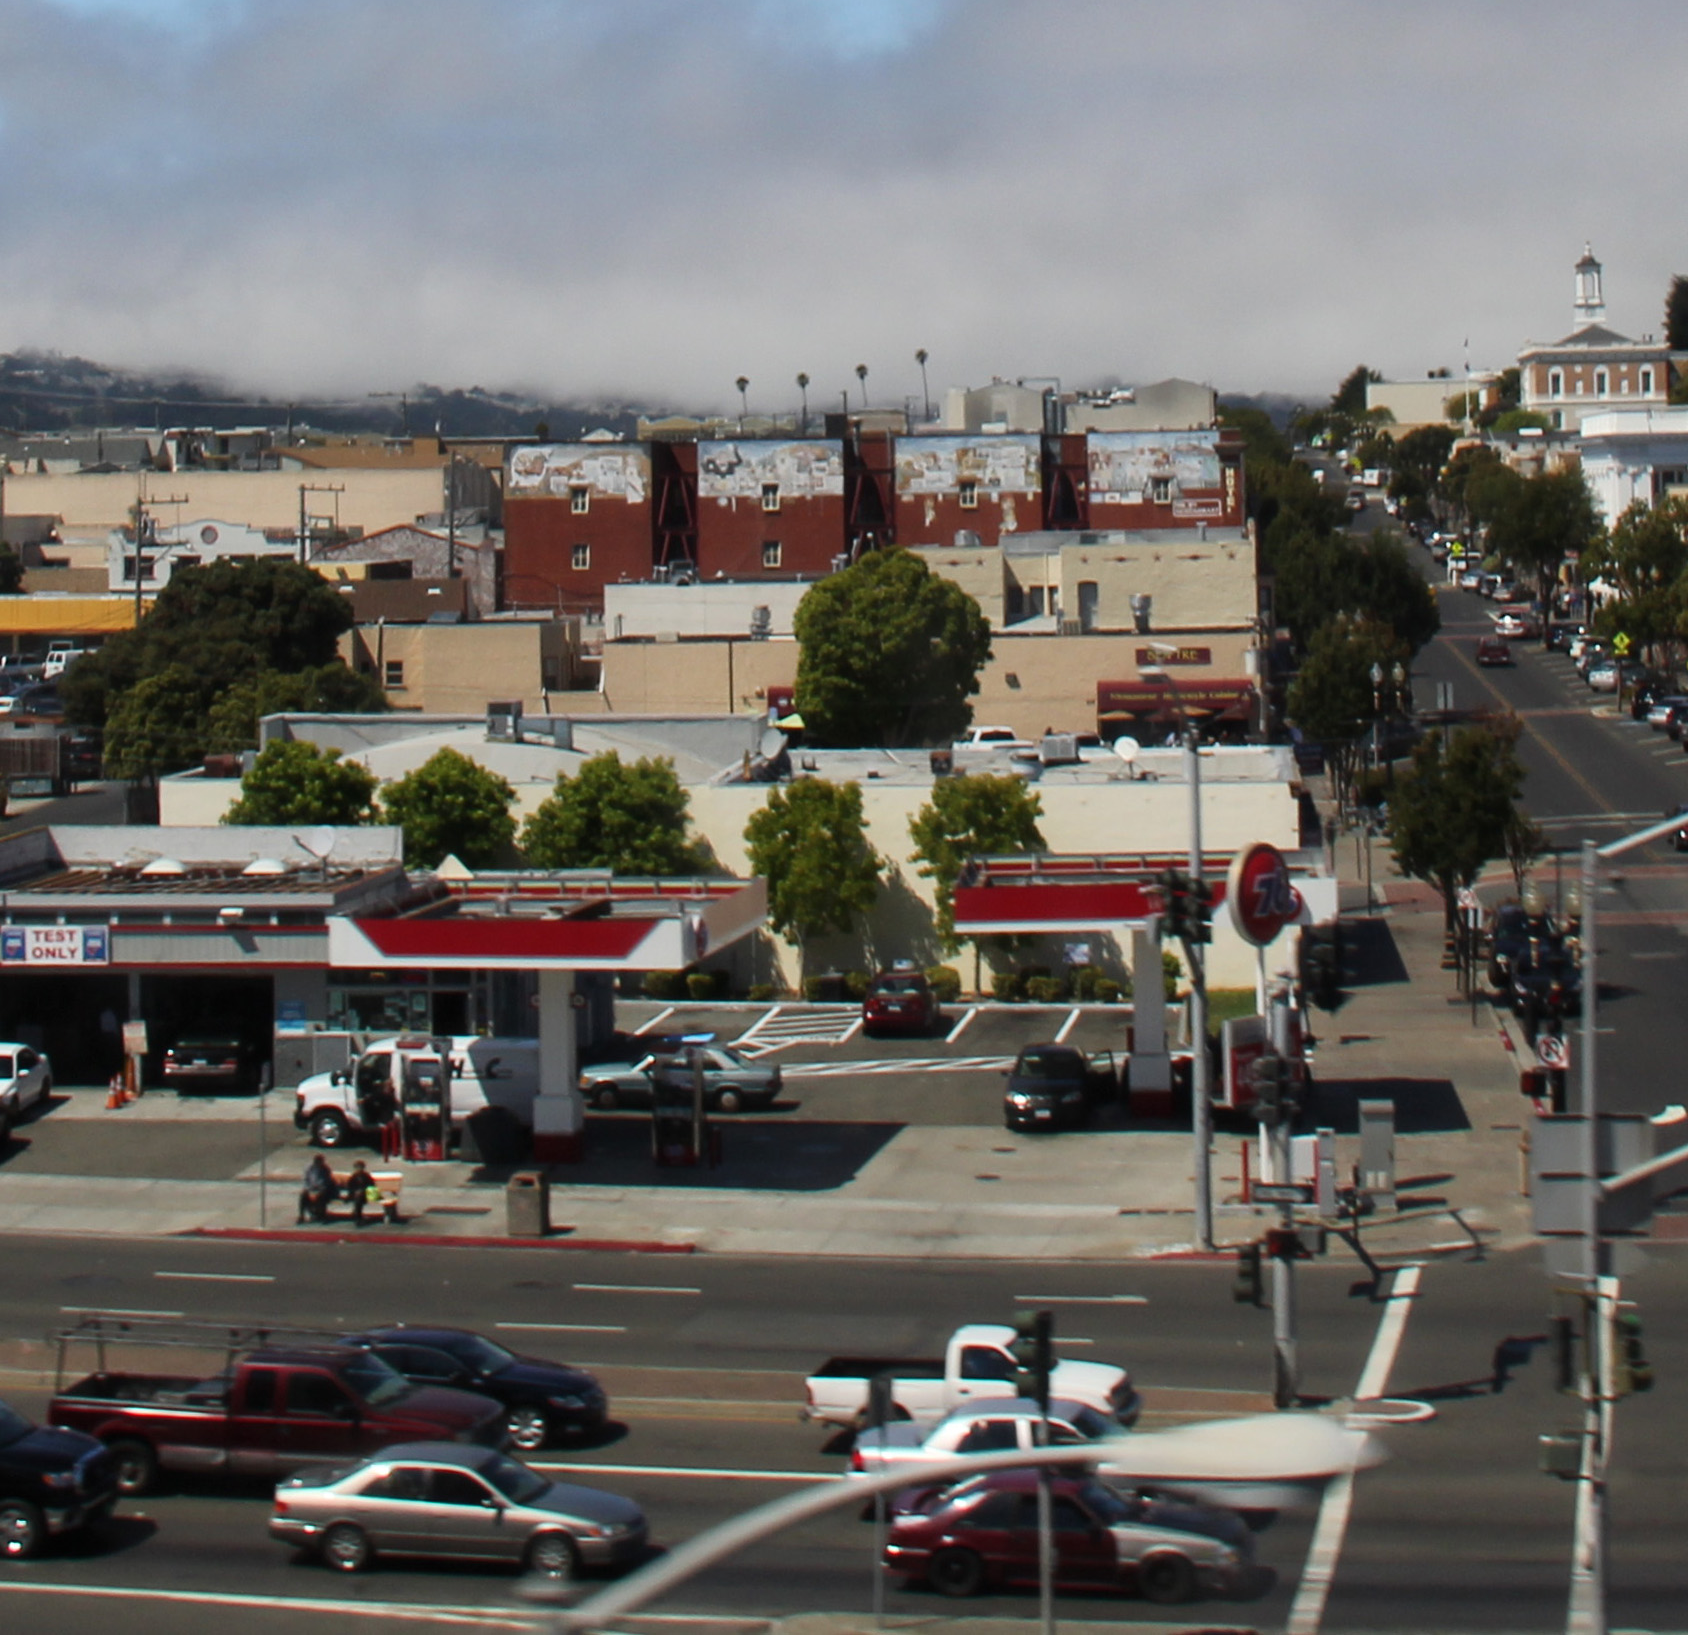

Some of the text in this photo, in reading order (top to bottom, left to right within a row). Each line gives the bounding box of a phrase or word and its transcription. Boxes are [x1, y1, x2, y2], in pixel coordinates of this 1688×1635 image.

[1225, 467, 1235, 513] HOTEL
[1253, 869, 1286, 916] 76
[32, 929, 77, 943] TEST
[31, 946, 78, 959] ONLY
